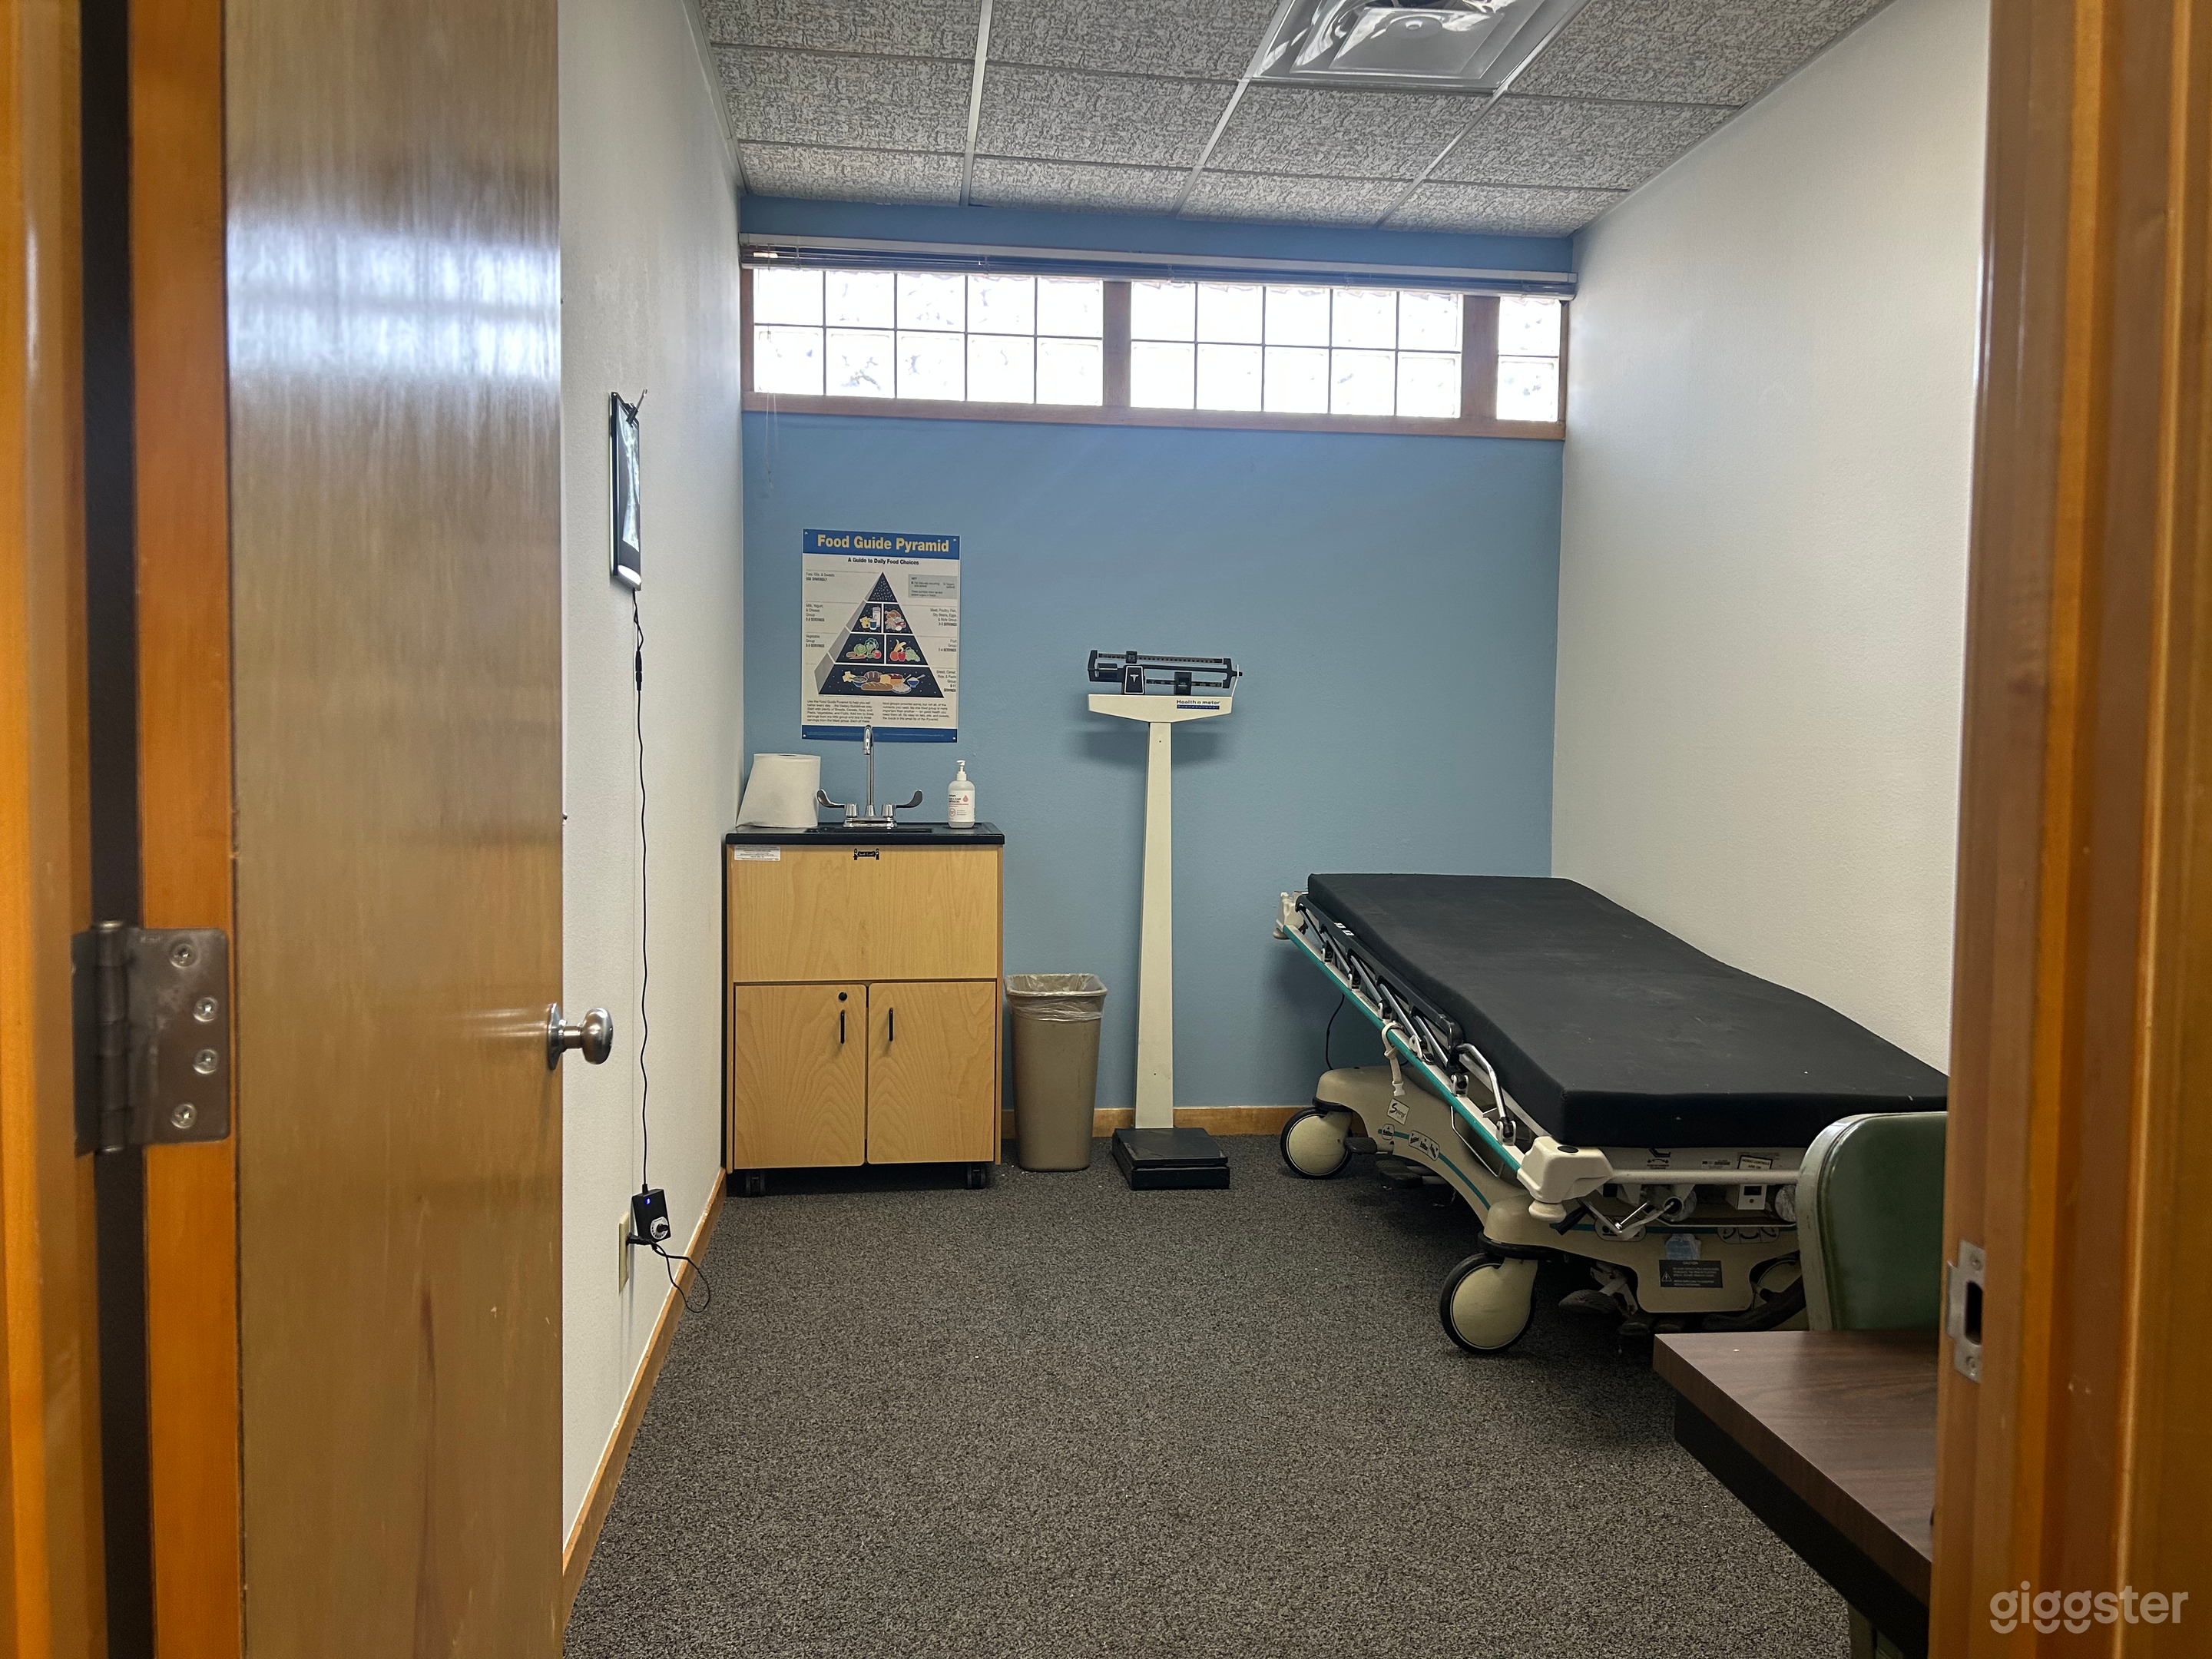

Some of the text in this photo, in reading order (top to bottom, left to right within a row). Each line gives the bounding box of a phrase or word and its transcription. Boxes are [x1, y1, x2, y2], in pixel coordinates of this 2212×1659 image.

[818, 534, 949, 553] Food Guide Pyramid
